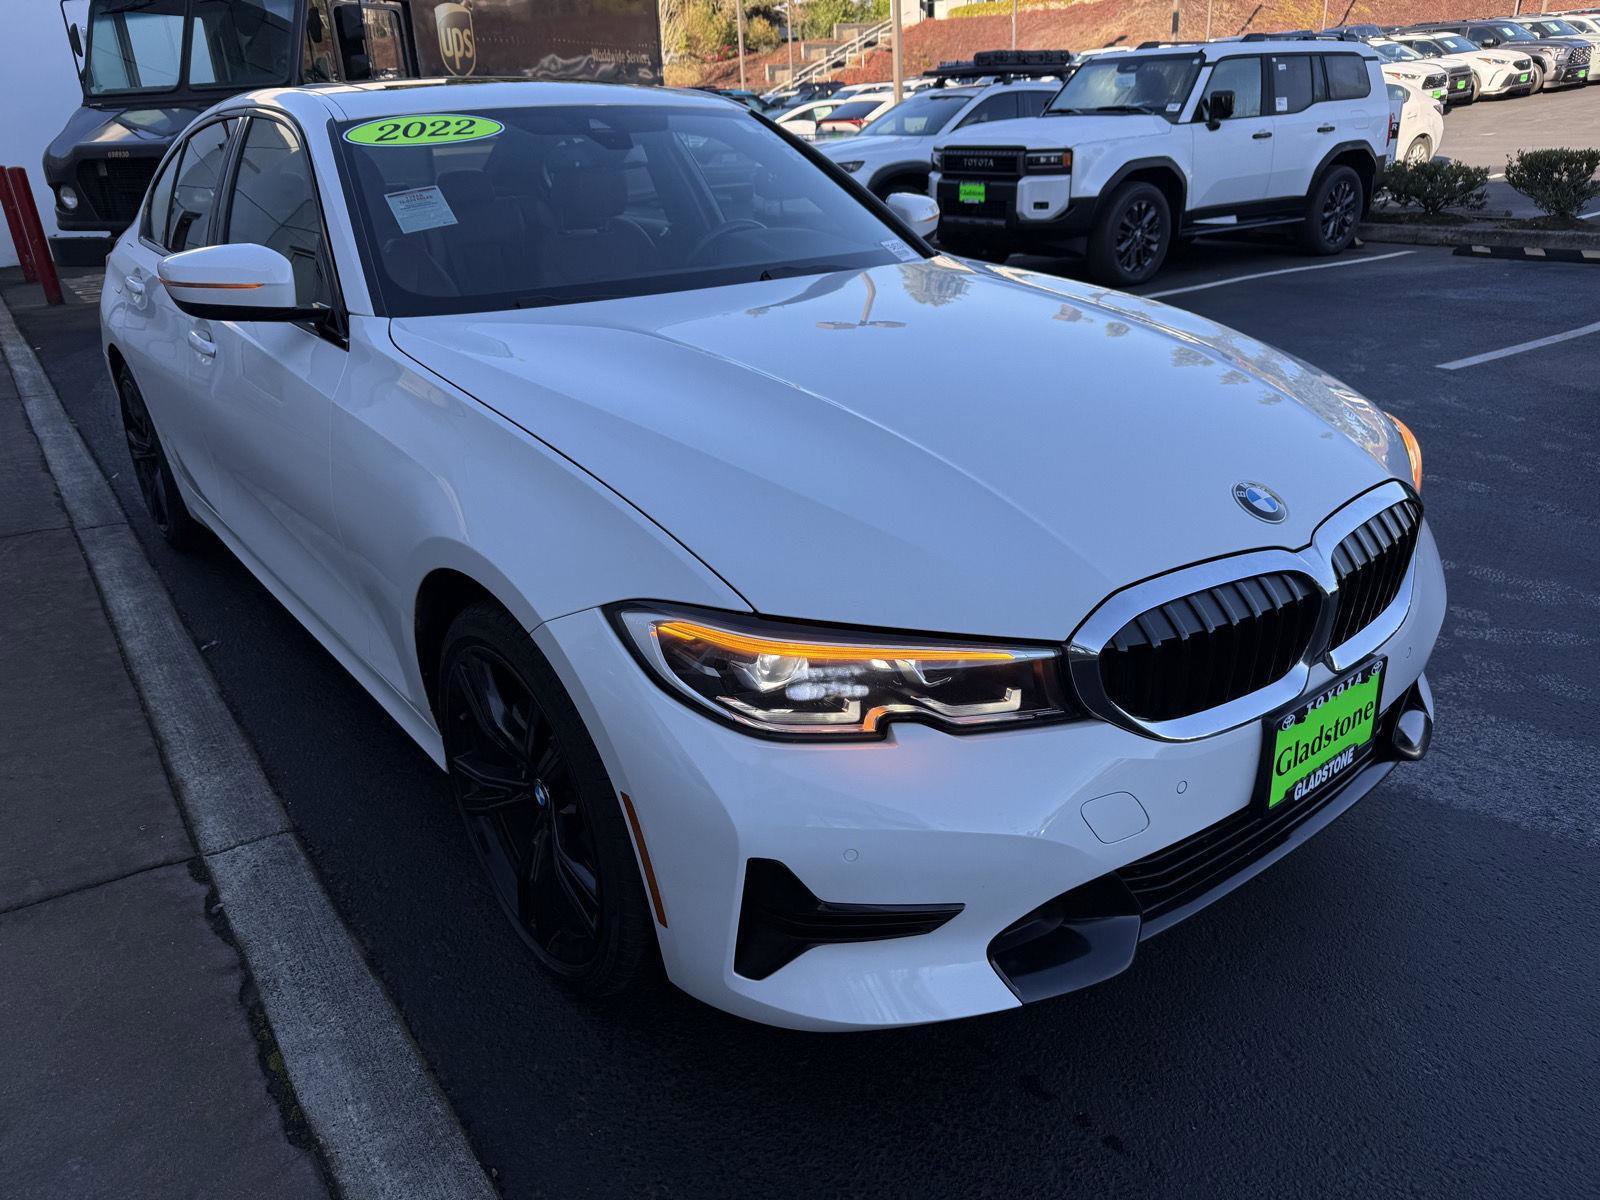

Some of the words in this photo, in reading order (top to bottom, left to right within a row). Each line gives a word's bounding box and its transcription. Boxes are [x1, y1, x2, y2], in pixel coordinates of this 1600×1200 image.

[591, 48, 625, 63] Worldwide
[626, 51, 651, 65] Services
[375, 119, 476, 142] 2022
[963, 158, 994, 168] TOYOTA
[1306, 673, 1362, 714] TOYOTA
[1276, 701, 1374, 777] Gladstone
[1294, 746, 1355, 801] GLADSTONE
